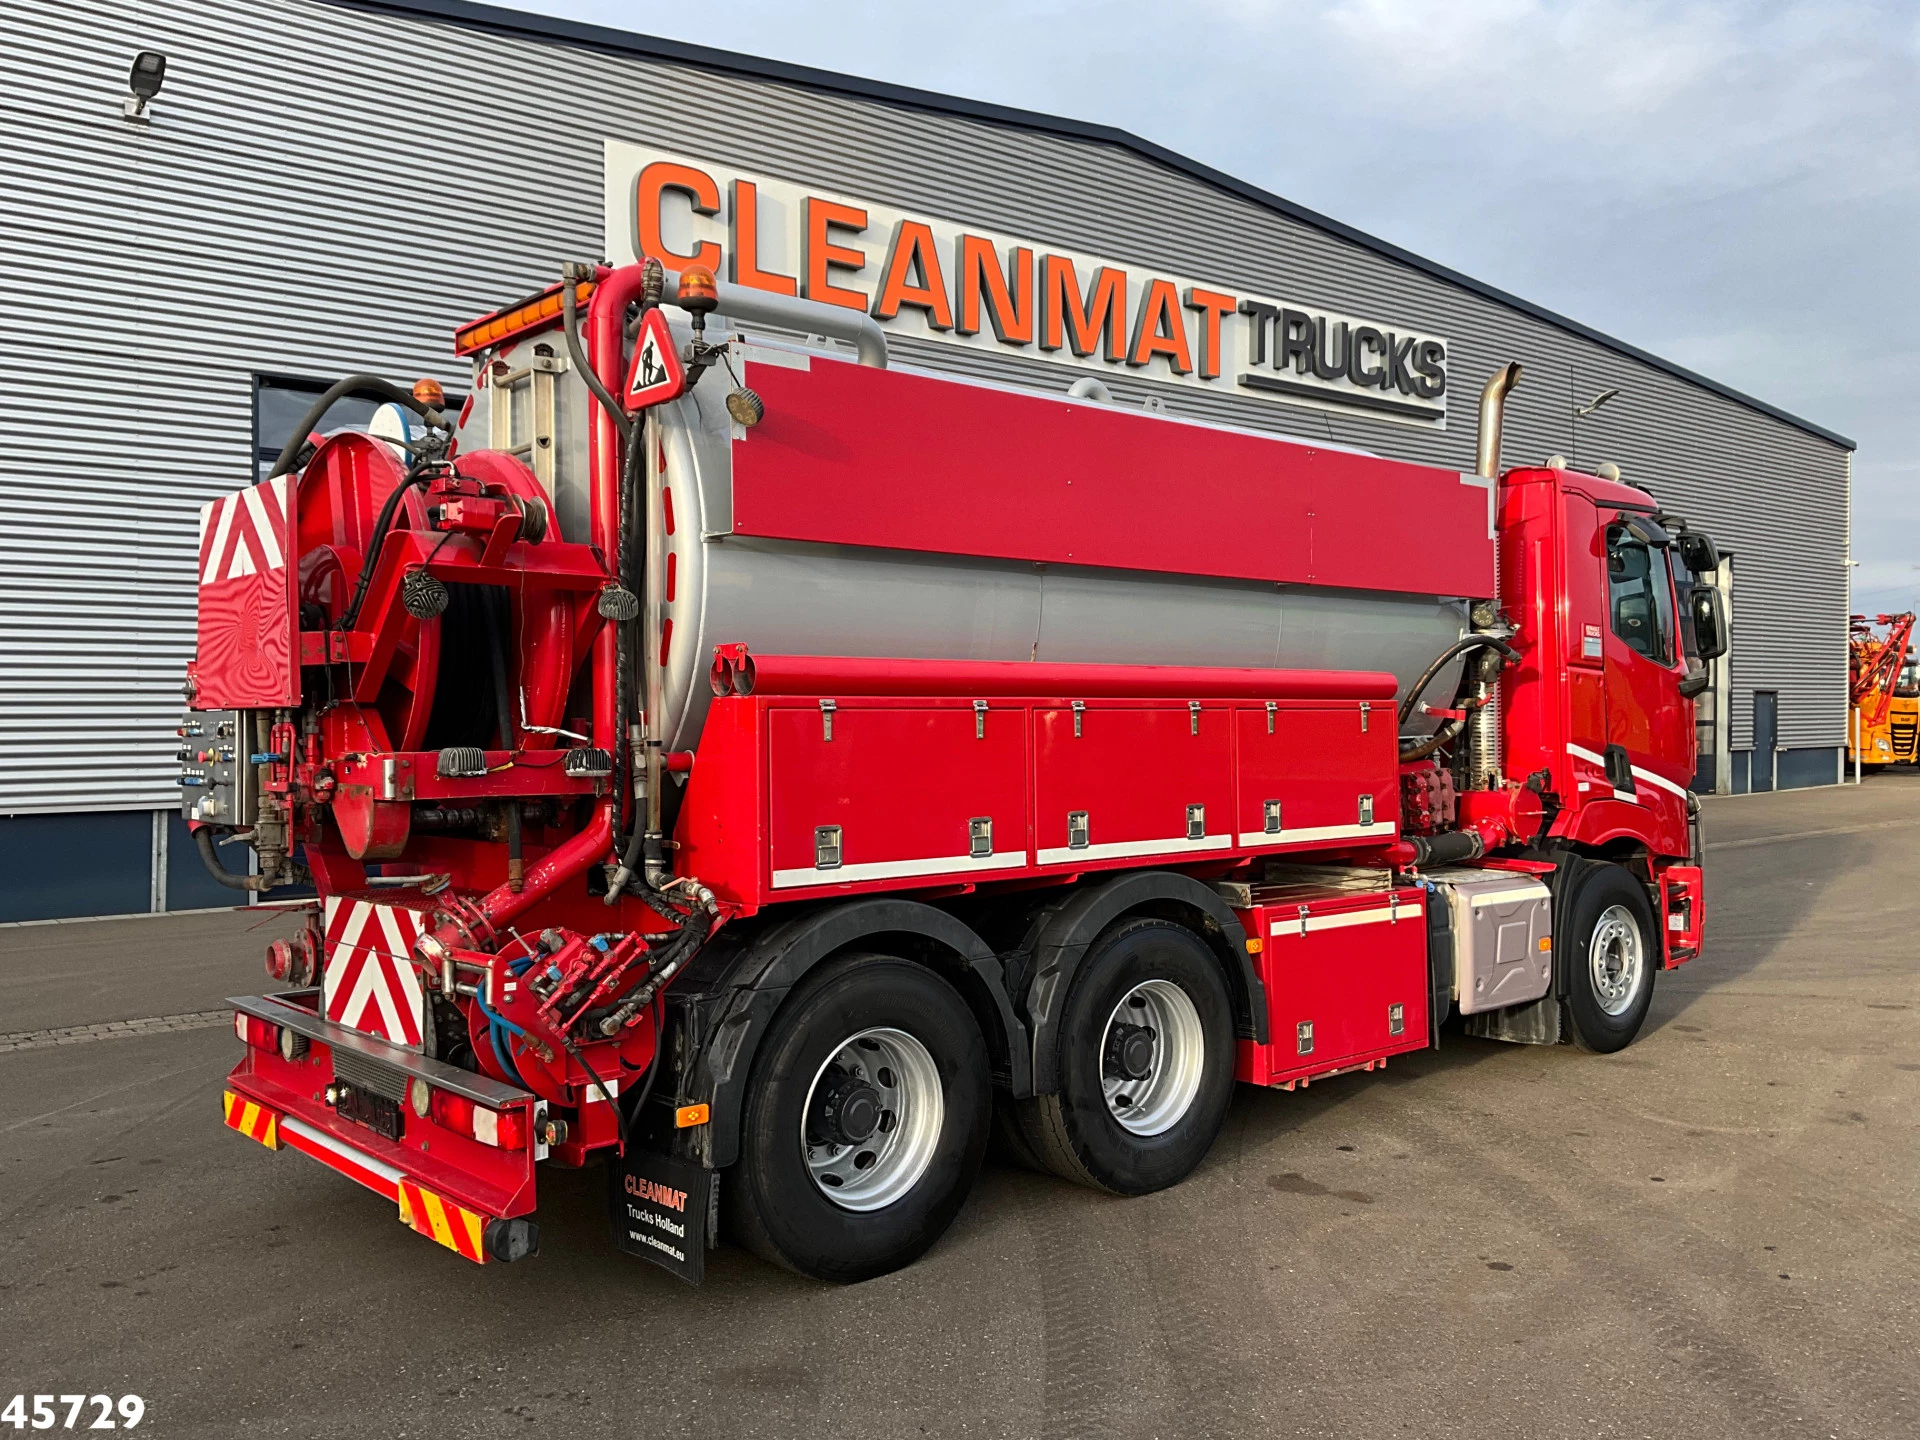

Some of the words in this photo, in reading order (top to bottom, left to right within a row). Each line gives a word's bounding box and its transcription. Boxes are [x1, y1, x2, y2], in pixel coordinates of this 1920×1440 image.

[631, 161, 1237, 379] CLEANMAT
[1238, 300, 1446, 398] TRUCKS
[624, 1174, 688, 1212] CLEANMAT
[626, 1203, 654, 1225] Trucks
[654, 1213, 685, 1238] Holland
[629, 1230, 685, 1262] www.cleanmat.eu
